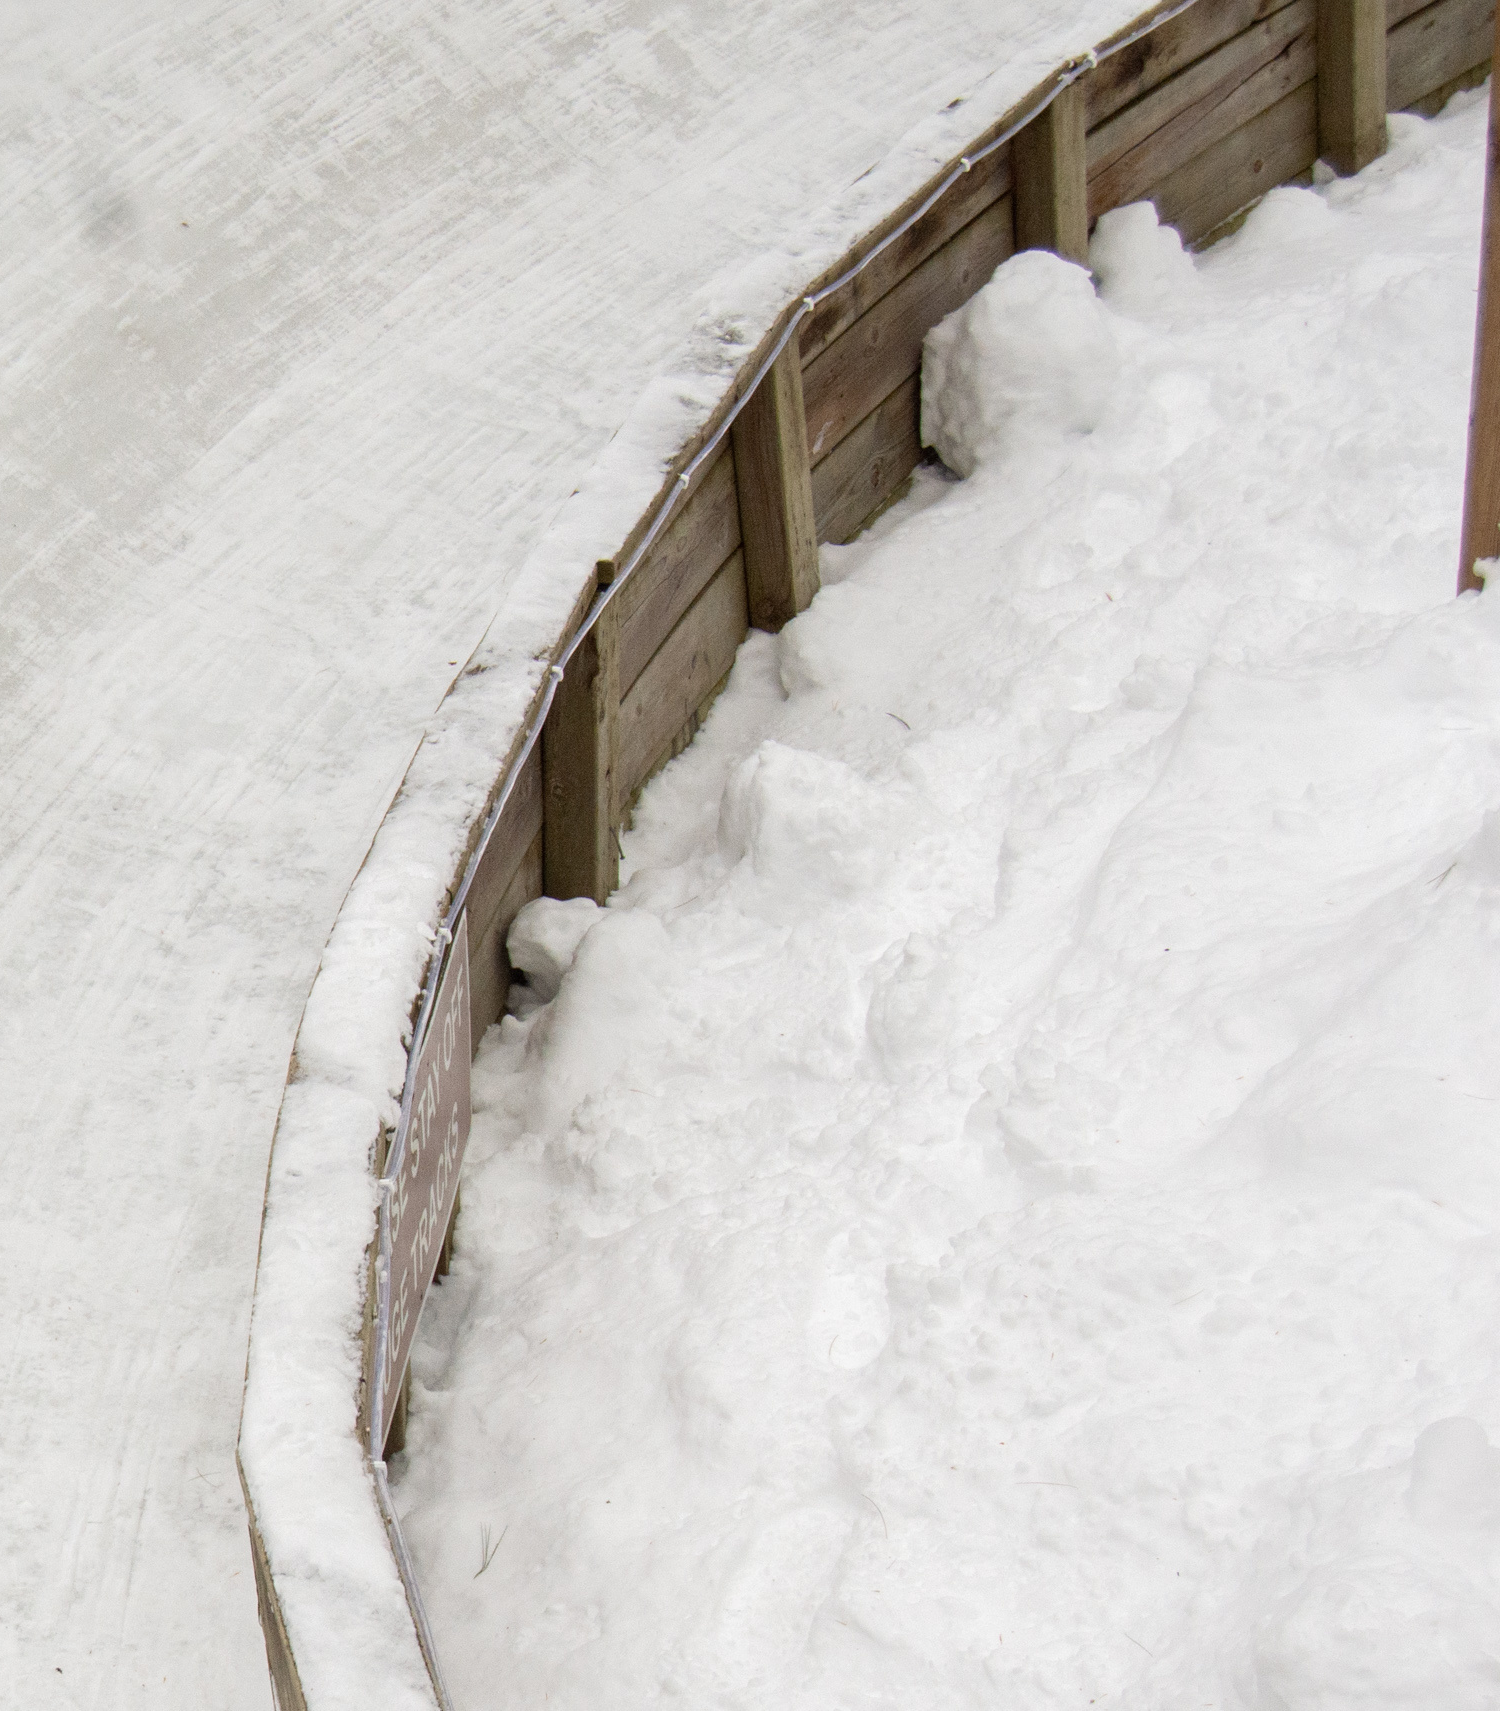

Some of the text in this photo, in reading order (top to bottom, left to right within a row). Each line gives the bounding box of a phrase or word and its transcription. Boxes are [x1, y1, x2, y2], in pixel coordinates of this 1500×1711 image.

[410, 963, 464, 1178] STAY OFF
[383, 1267, 409, 1396] UGE
[410, 1101, 459, 1291] TRACKS
